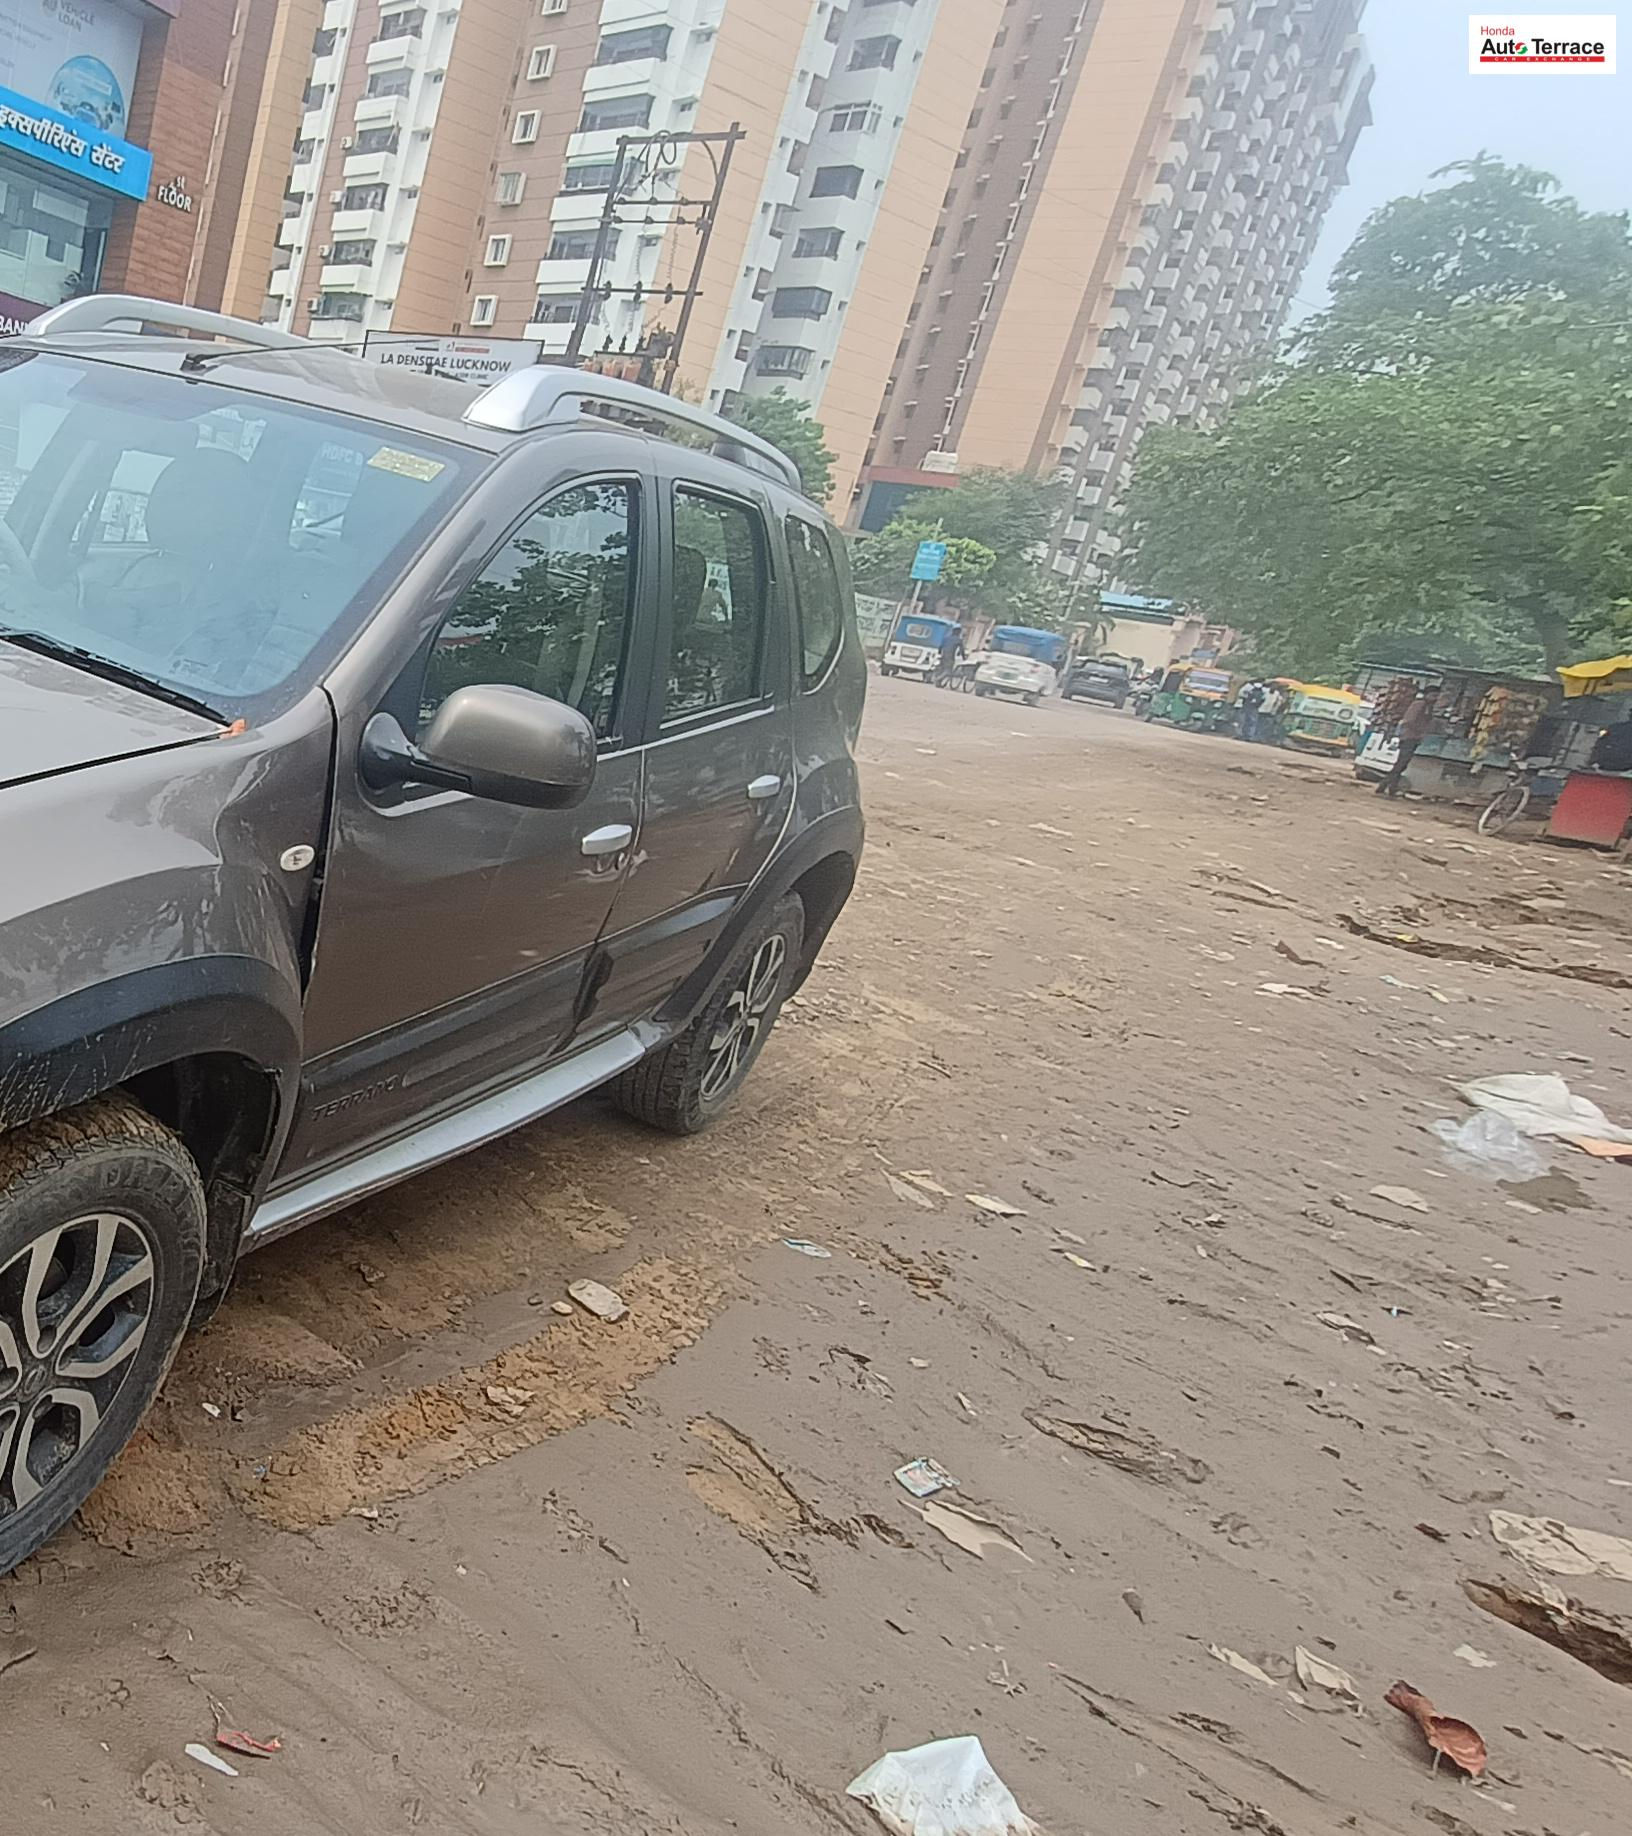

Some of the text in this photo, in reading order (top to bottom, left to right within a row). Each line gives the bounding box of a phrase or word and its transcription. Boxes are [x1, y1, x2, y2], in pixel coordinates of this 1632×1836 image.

[90, 142, 126, 175] सेंटर
[157, 185, 193, 213] FLOOR
[380, 353, 394, 365] LA
[450, 357, 512, 373] LUCKNOW
